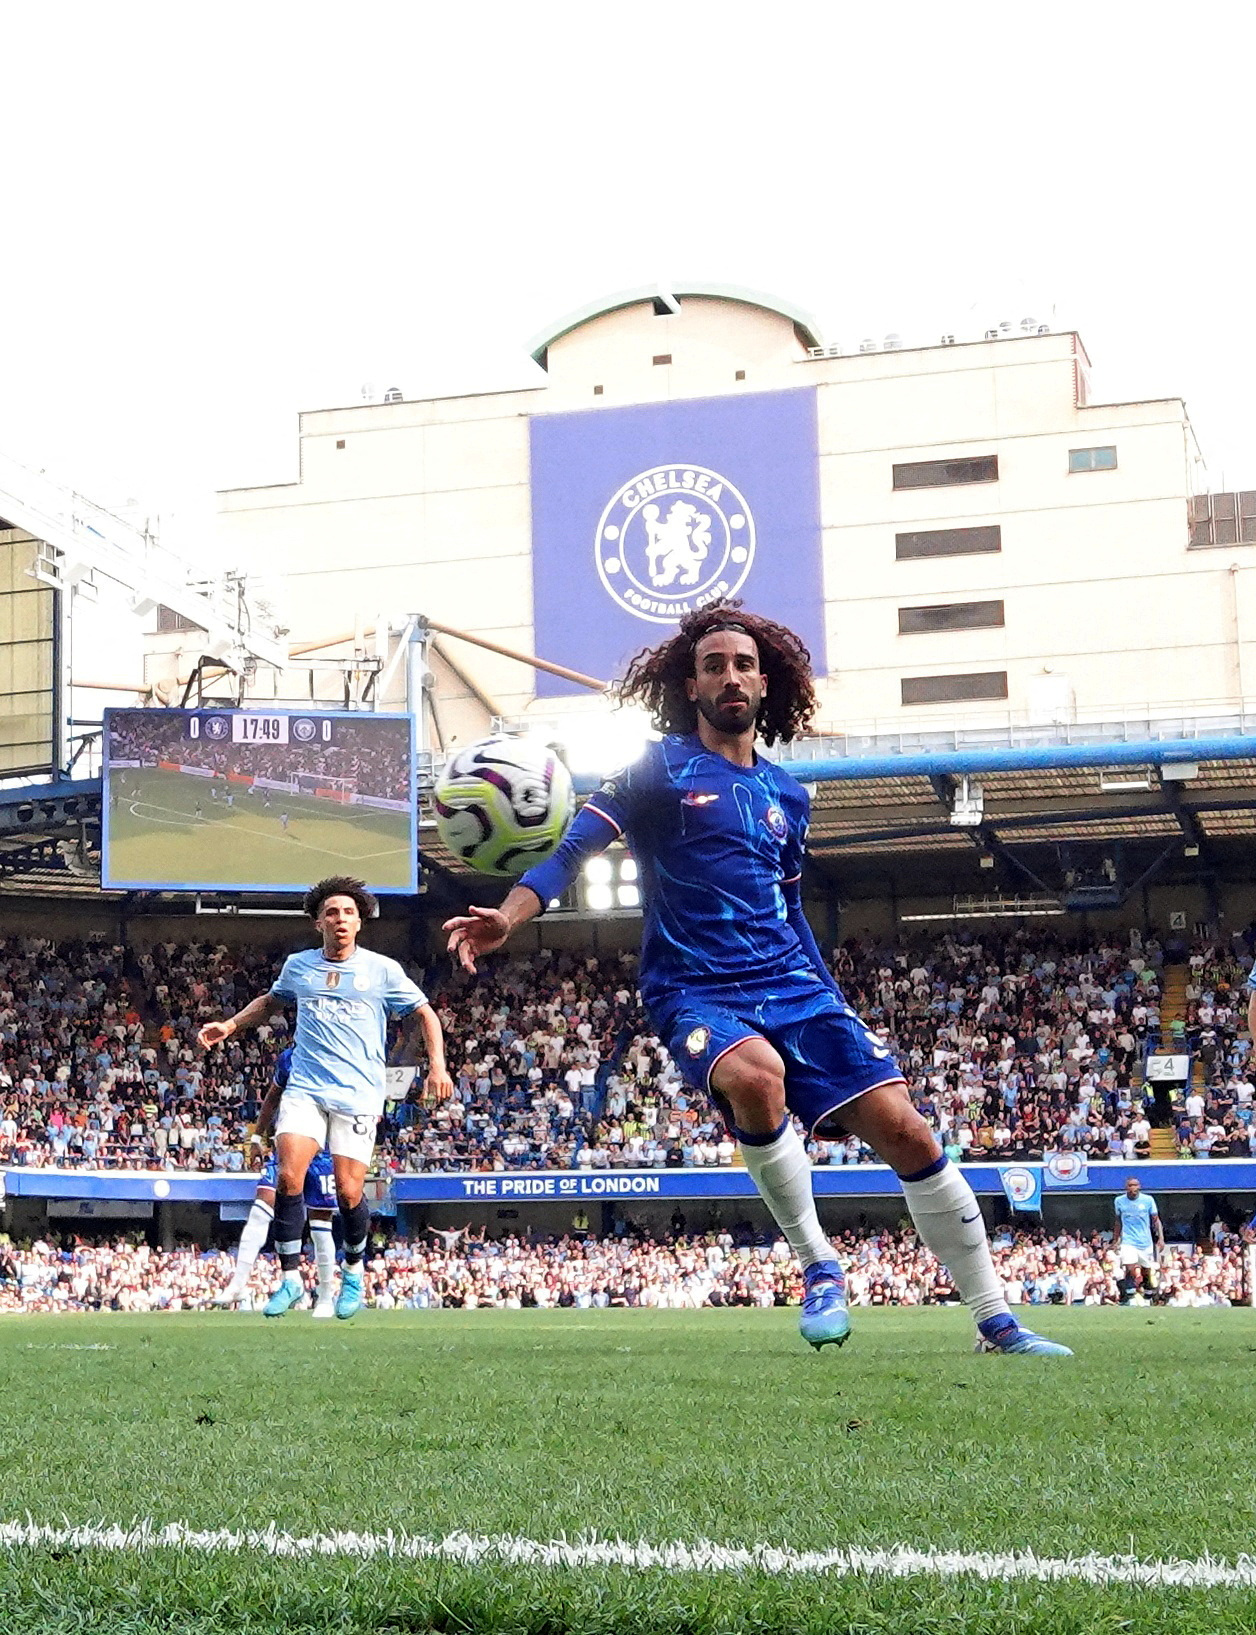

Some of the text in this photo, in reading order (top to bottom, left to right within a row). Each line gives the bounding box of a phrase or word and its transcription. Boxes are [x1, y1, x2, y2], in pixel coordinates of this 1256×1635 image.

[622, 470, 724, 508] CHELSEA
[623, 588, 692, 615] FOOTBALL
[189, 717, 332, 742] 0 17:49 0
[394, 1069, 404, 1083] 2
[463, 1177, 660, 1195] THE PRIDE OF LONDON
